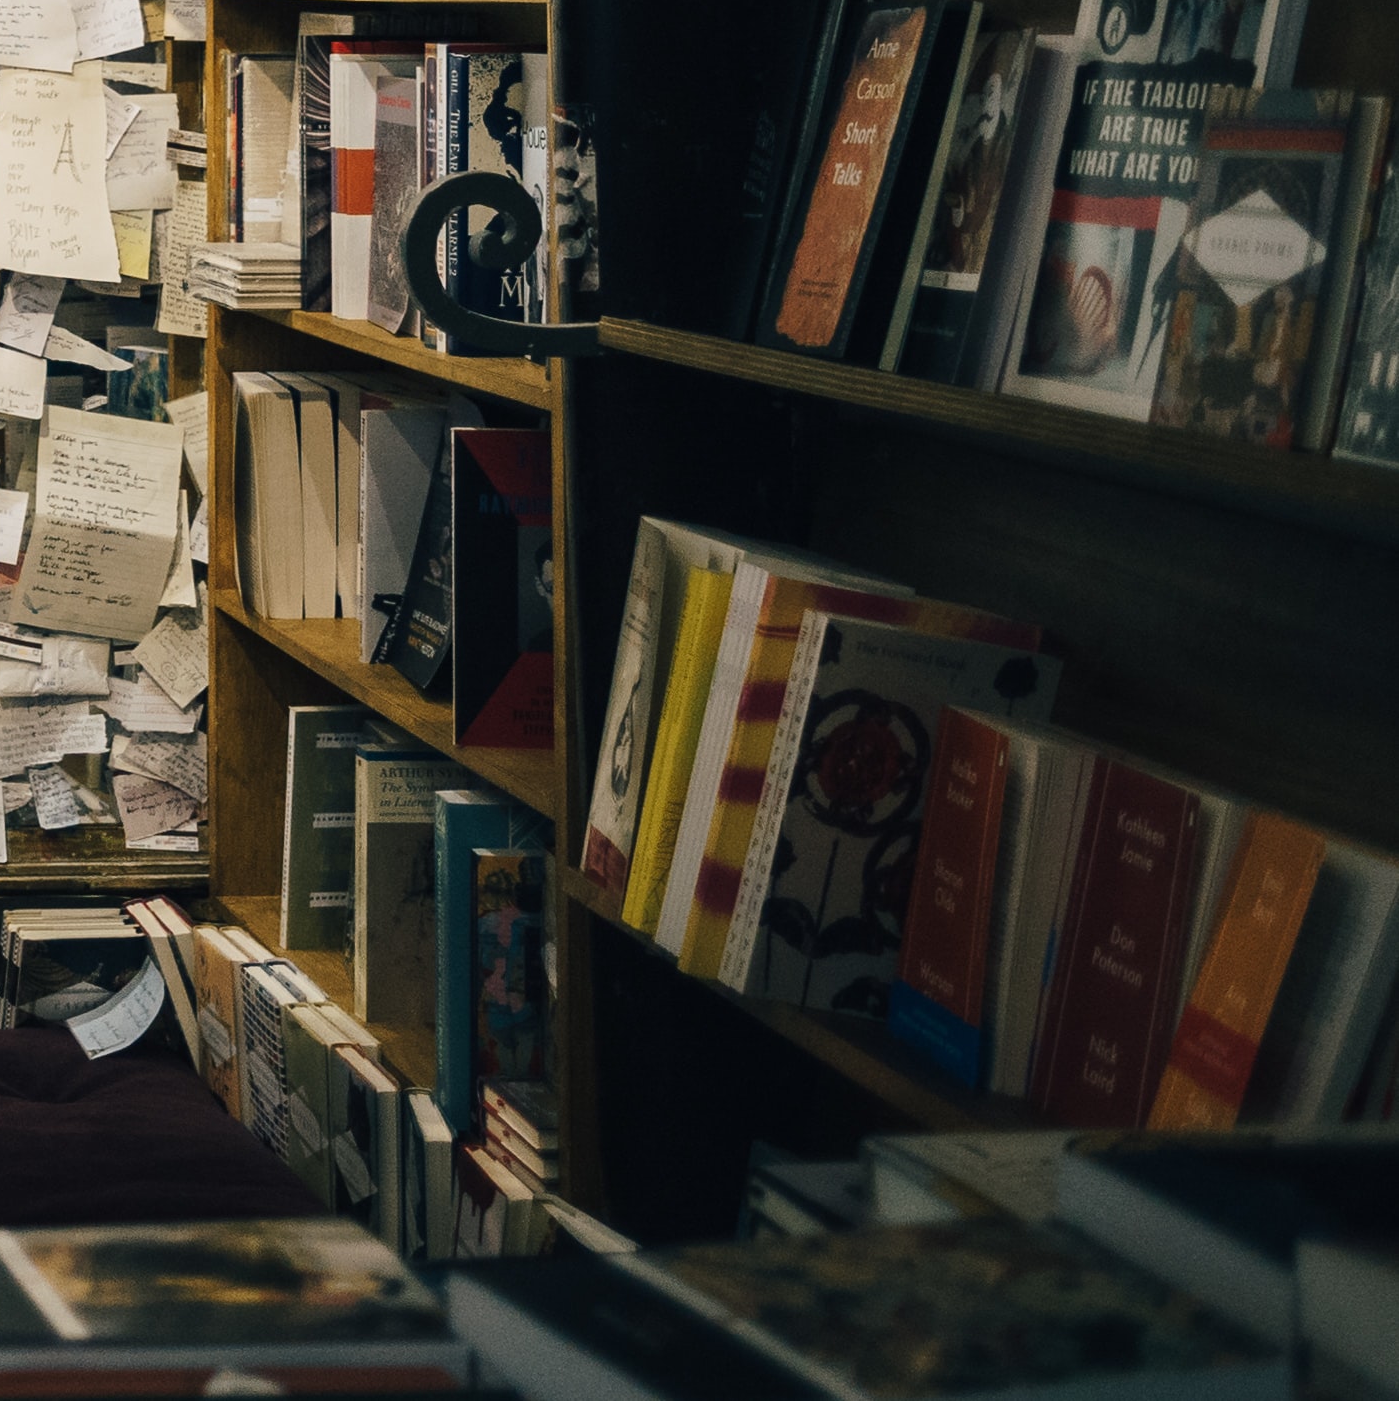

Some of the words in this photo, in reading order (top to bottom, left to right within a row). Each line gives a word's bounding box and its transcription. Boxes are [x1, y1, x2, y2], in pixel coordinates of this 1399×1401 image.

[866, 38, 900, 59] Anne
[857, 78, 896, 100] Carson
[1083, 79, 1099, 106] IF
[1102, 79, 1135, 107] THE
[842, 122, 876, 145] Short
[1099, 115, 1133, 143] ARE
[1141, 117, 1190, 146] TRUE
[831, 162, 863, 186] Talks
[1070, 150, 1119, 178] WHAT
[1123, 151, 1160, 181] ARE
[1116, 809, 1166, 848] Kathleen
[1119, 844, 1154, 873] Jamie
[1109, 925, 1136, 955] Don
[1091, 946, 1143, 990] Paterson
[1089, 1033, 1118, 1066] Nick
